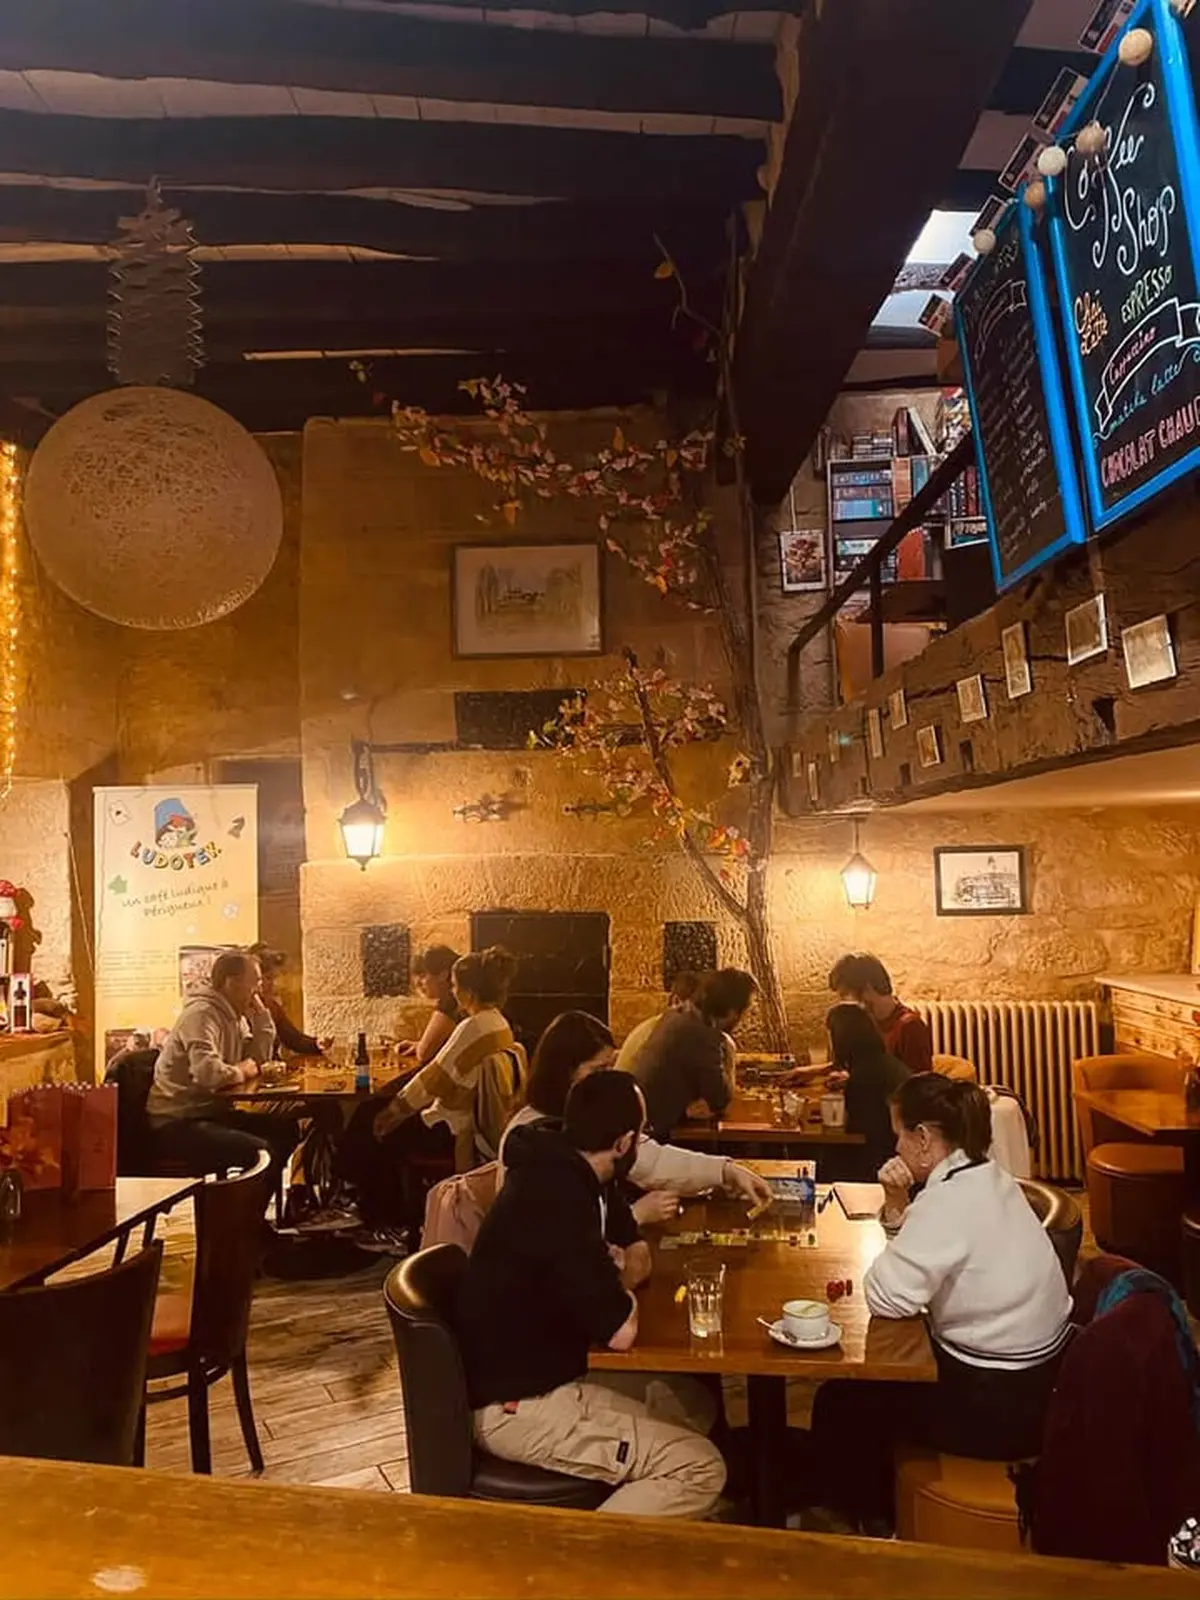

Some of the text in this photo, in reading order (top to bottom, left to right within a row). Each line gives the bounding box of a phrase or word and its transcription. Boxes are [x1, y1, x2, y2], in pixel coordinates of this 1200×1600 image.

[1064, 81, 1155, 268] Coffee
[1117, 185, 1175, 276] Shop
[1121, 264, 1173, 323] ESPRESSO
[1151, 363, 1182, 396] latte
[1101, 428, 1156, 488] CHOCOLAT
[130, 841, 222, 871] LUDOTEK
[122, 897, 141, 907] un
[144, 888, 168, 903] café
